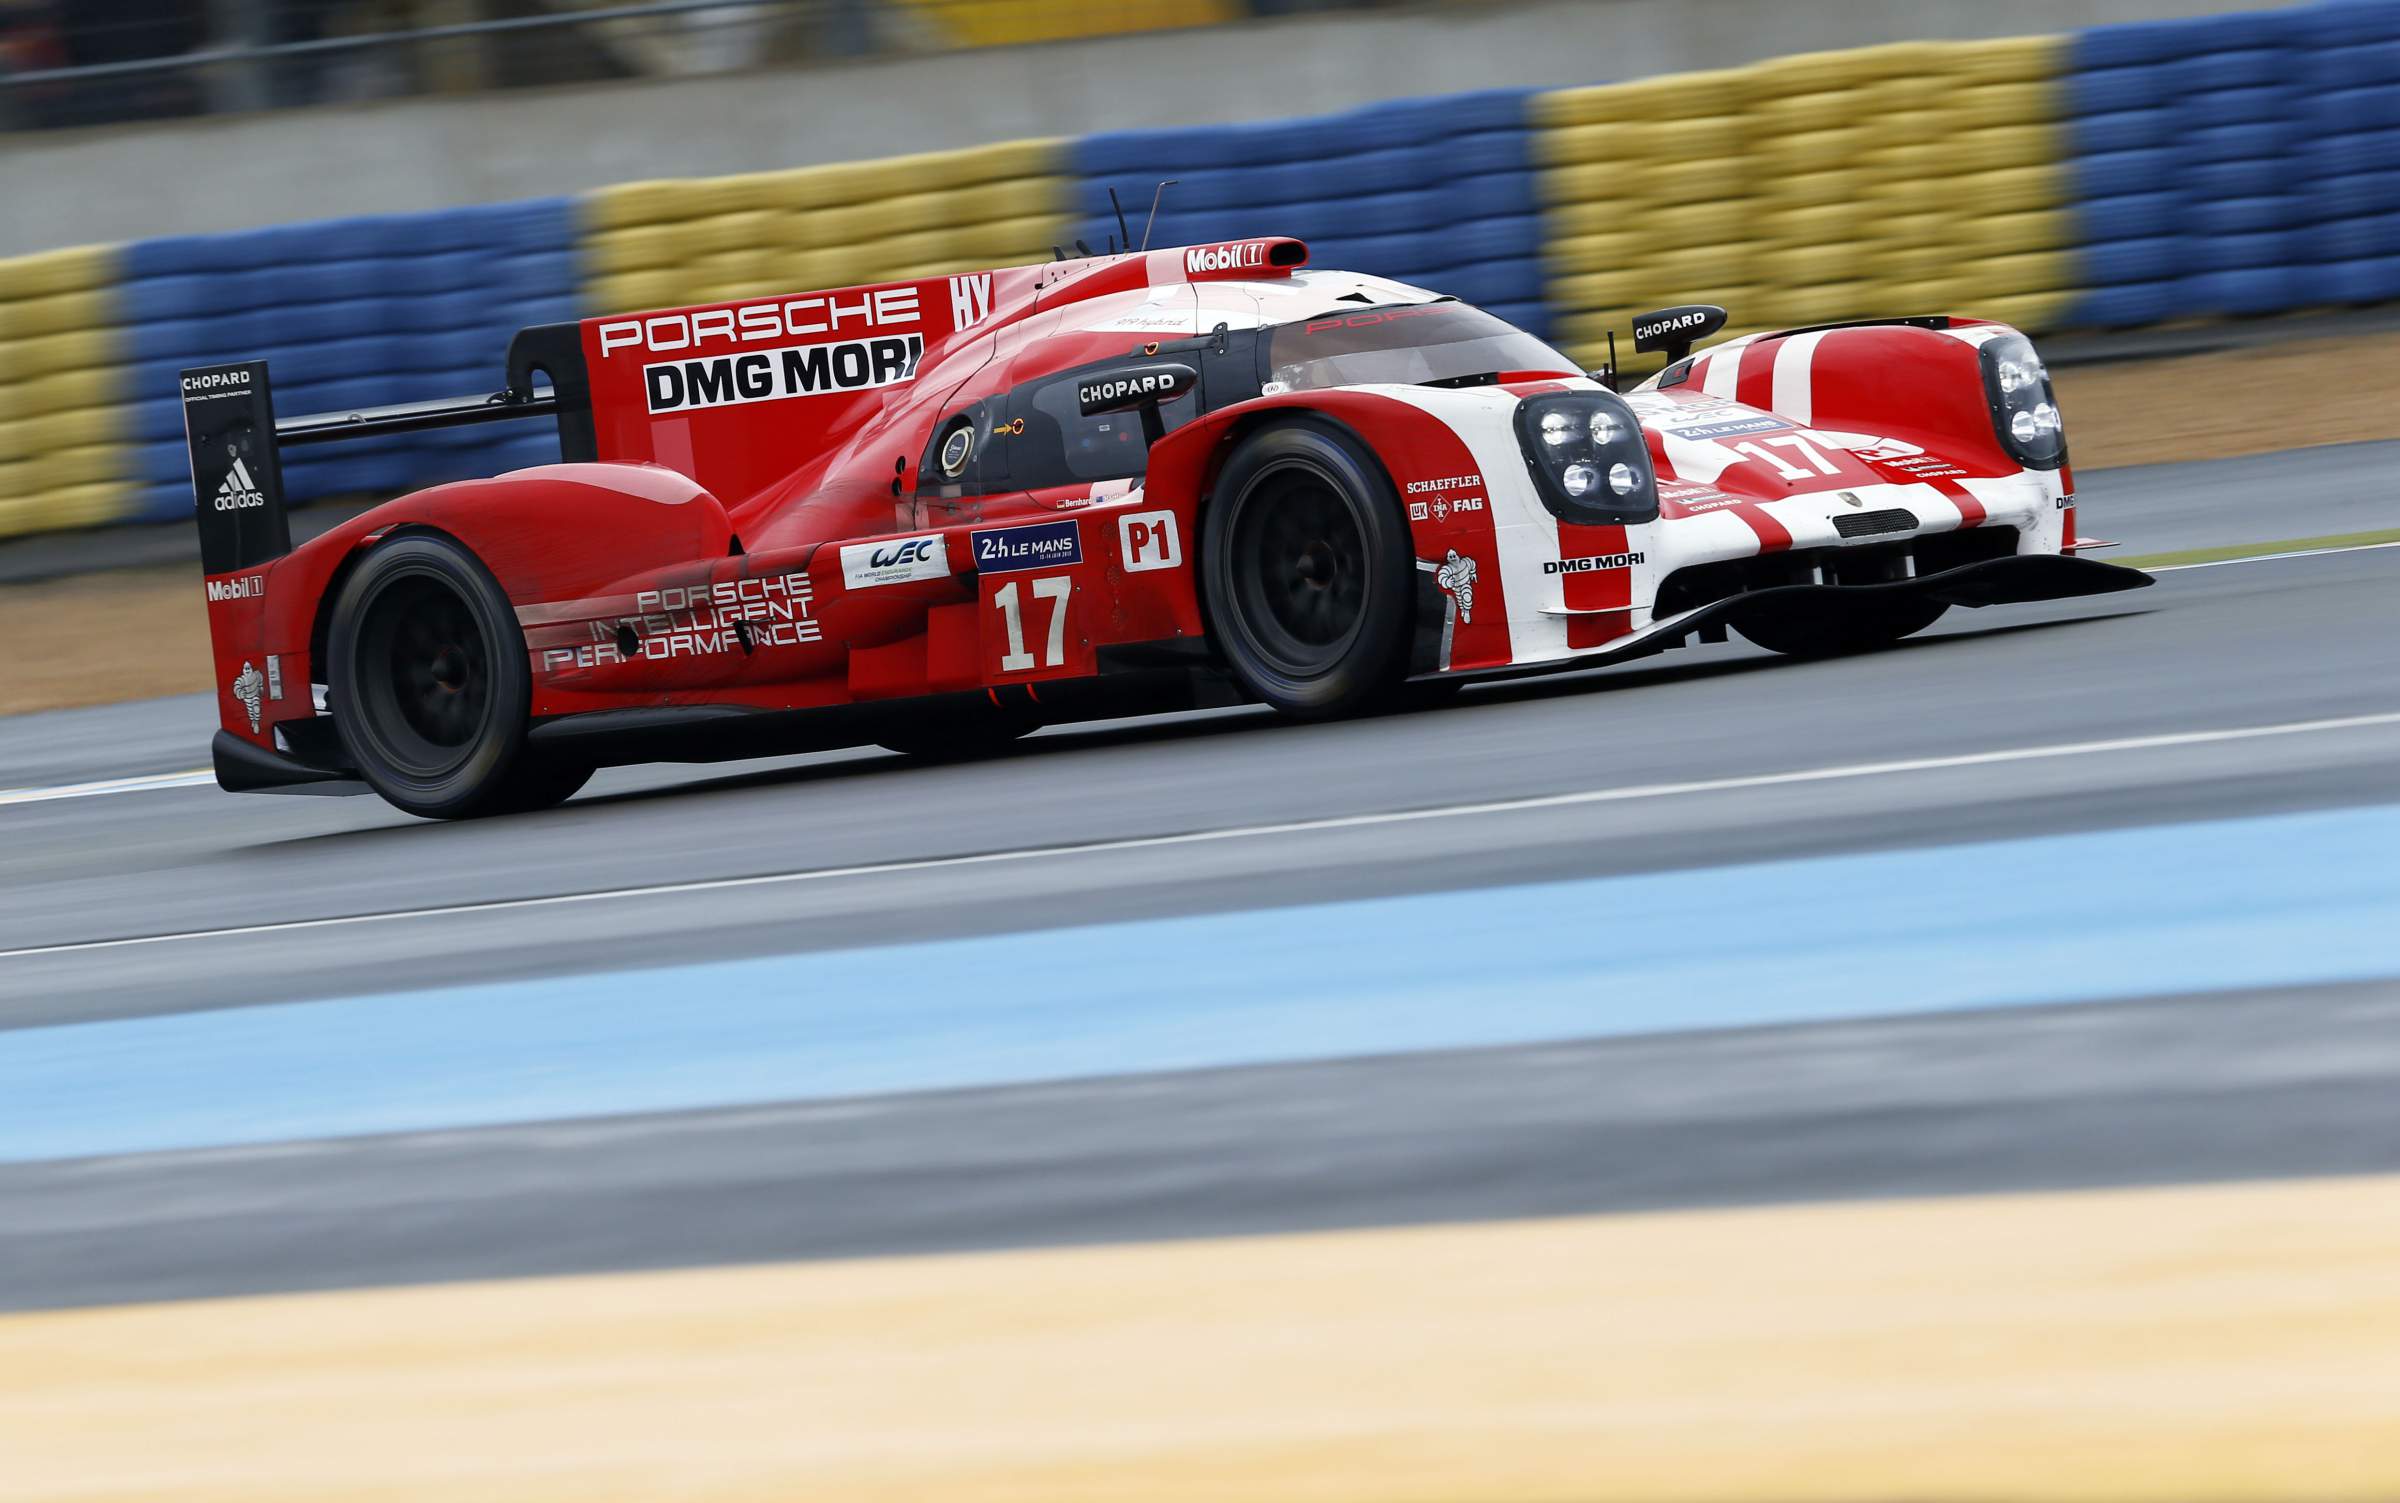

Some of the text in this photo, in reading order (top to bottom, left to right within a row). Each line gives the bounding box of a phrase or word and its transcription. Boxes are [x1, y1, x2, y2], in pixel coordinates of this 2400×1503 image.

[1187, 244, 1242, 273] Mobil
[949, 273, 992, 333] HY
[599, 286, 921, 358] PORSCHE
[1635, 312, 1706, 340] CHOPARD
[182, 370, 251, 390] CHOPARD
[645, 336, 925, 411] DMG MORI
[1079, 373, 1176, 404] CHOPARD
[1732, 435, 1842, 480] 17
[1406, 474, 1481, 494] SCHAEFFLER
[214, 489, 264, 511] adidas
[1453, 497, 1483, 513] FAG
[870, 540, 933, 568] WEC
[1011, 543, 1029, 557] LE
[1031, 537, 1073, 554] MANS
[1128, 519, 1171, 564] P1
[1543, 551, 1645, 575] DMG MORI
[207, 576, 250, 602] Mobil
[637, 572, 813, 613] PORSCHE
[588, 596, 814, 642] INTELLIGENT
[994, 575, 1072, 672] 17
